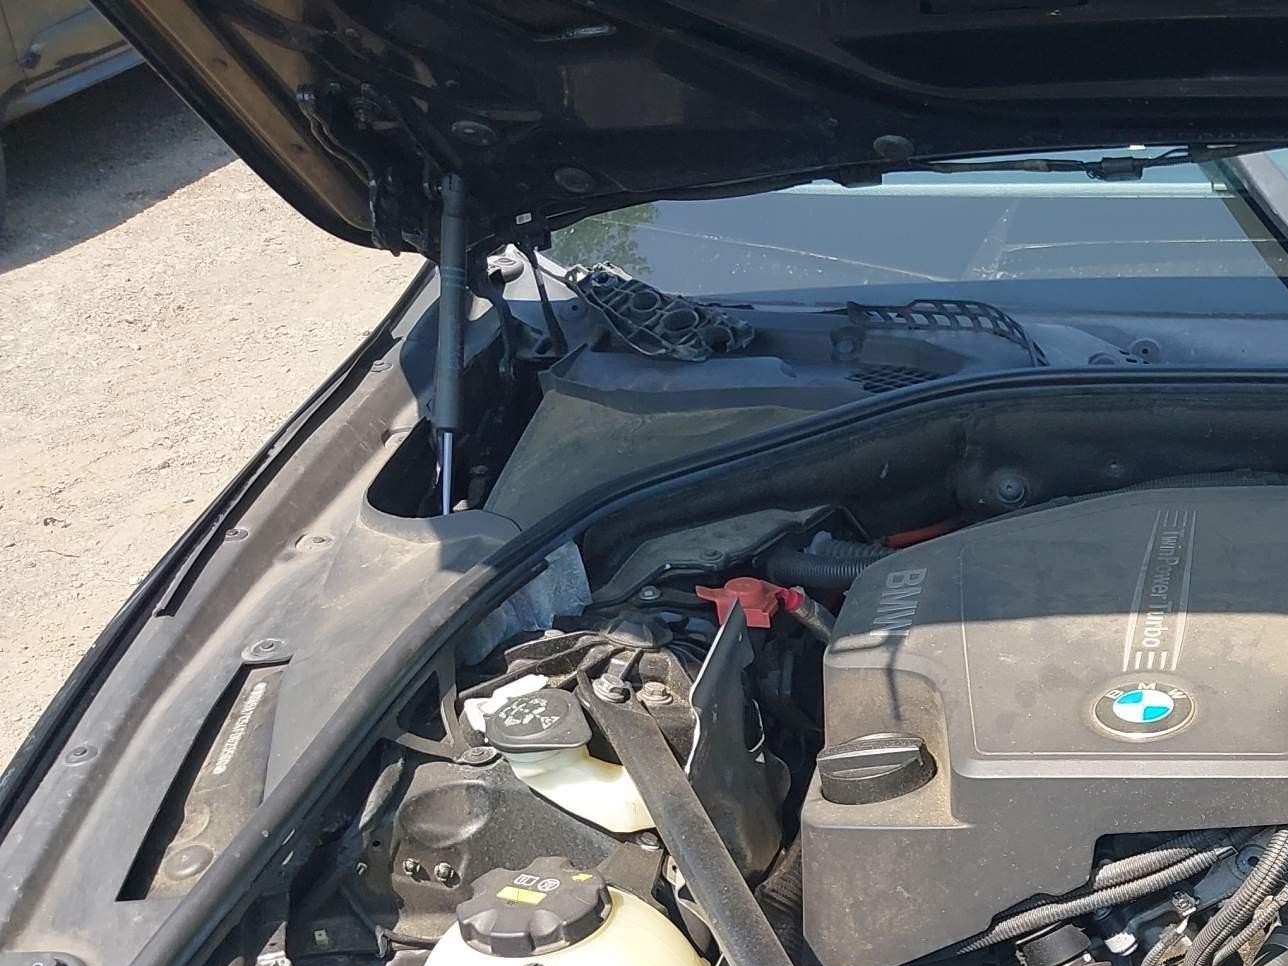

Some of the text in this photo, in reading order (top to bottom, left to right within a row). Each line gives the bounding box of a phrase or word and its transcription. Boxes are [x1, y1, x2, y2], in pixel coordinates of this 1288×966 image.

[869, 567, 928, 637] BMW
[1142, 528, 1187, 648] TwinPower Turbo
[1105, 682, 1187, 700] BMW
